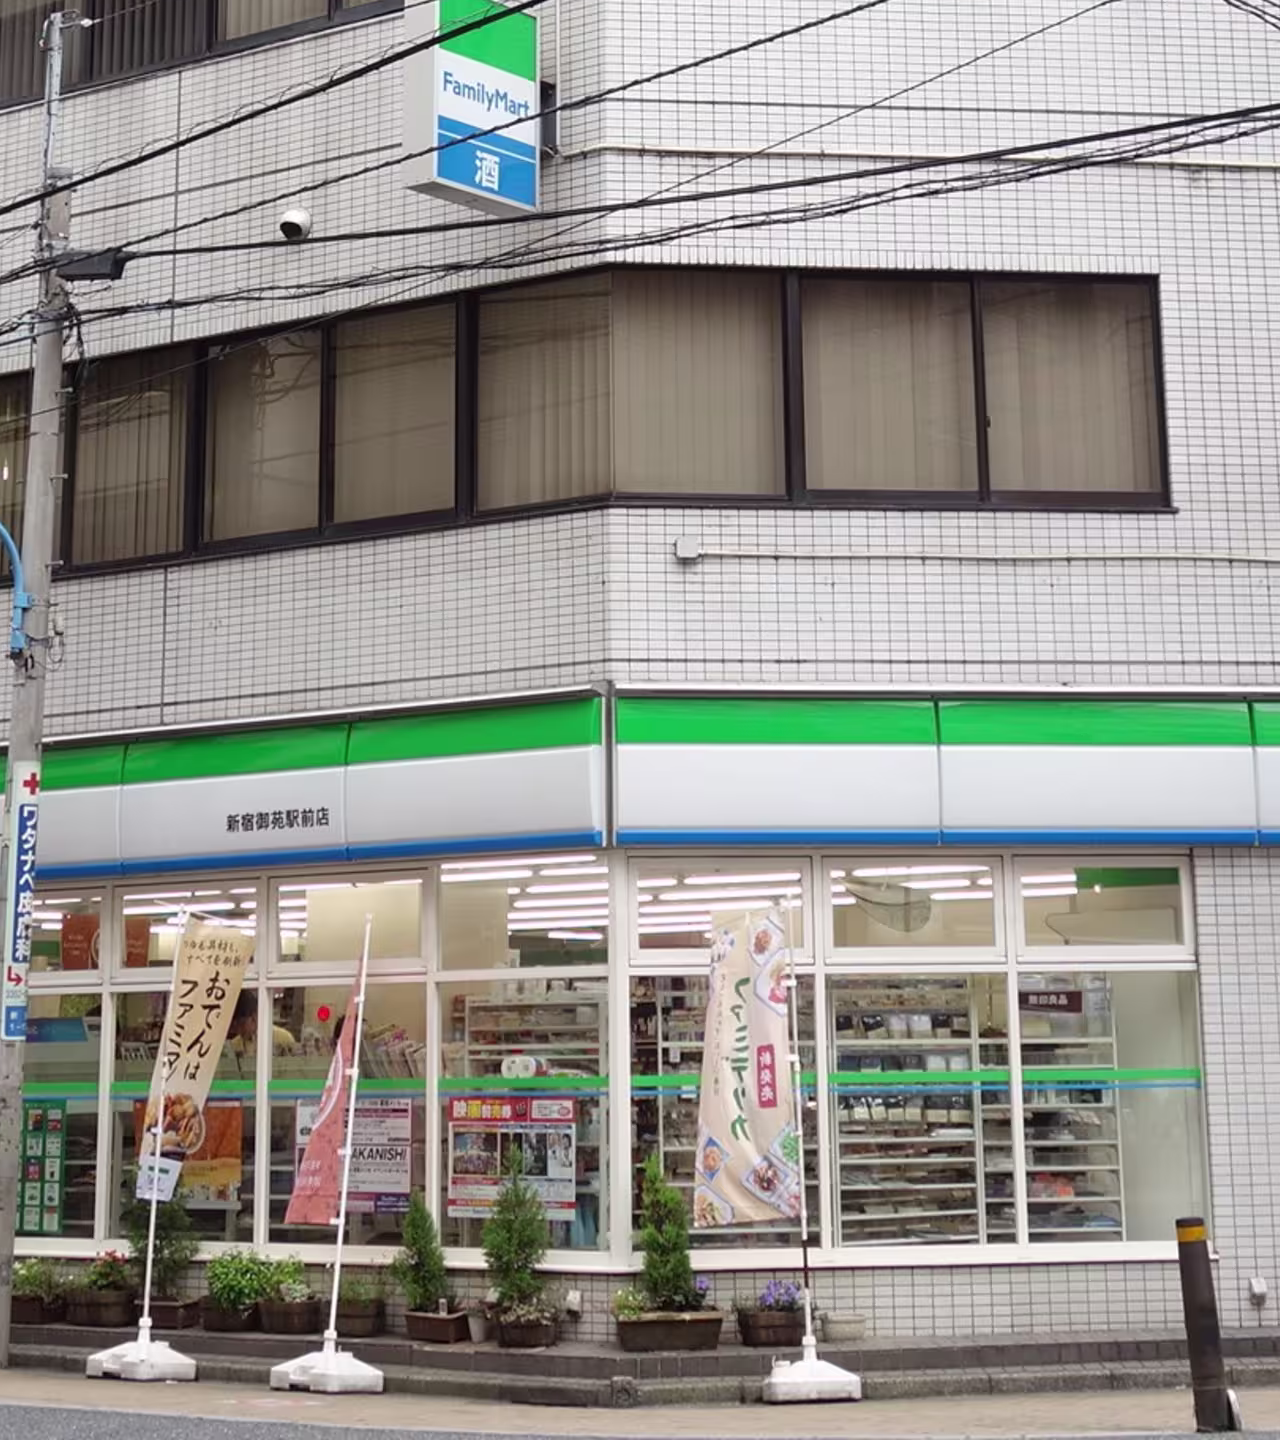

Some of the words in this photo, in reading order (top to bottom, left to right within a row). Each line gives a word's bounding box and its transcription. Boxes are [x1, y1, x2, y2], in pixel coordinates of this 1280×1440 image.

[443, 70, 530, 117] FamilyMart
[475, 149, 500, 191] 酒
[226, 807, 329, 832] 新宿御苑駅前店
[183, 970, 231, 1081] おでんは
